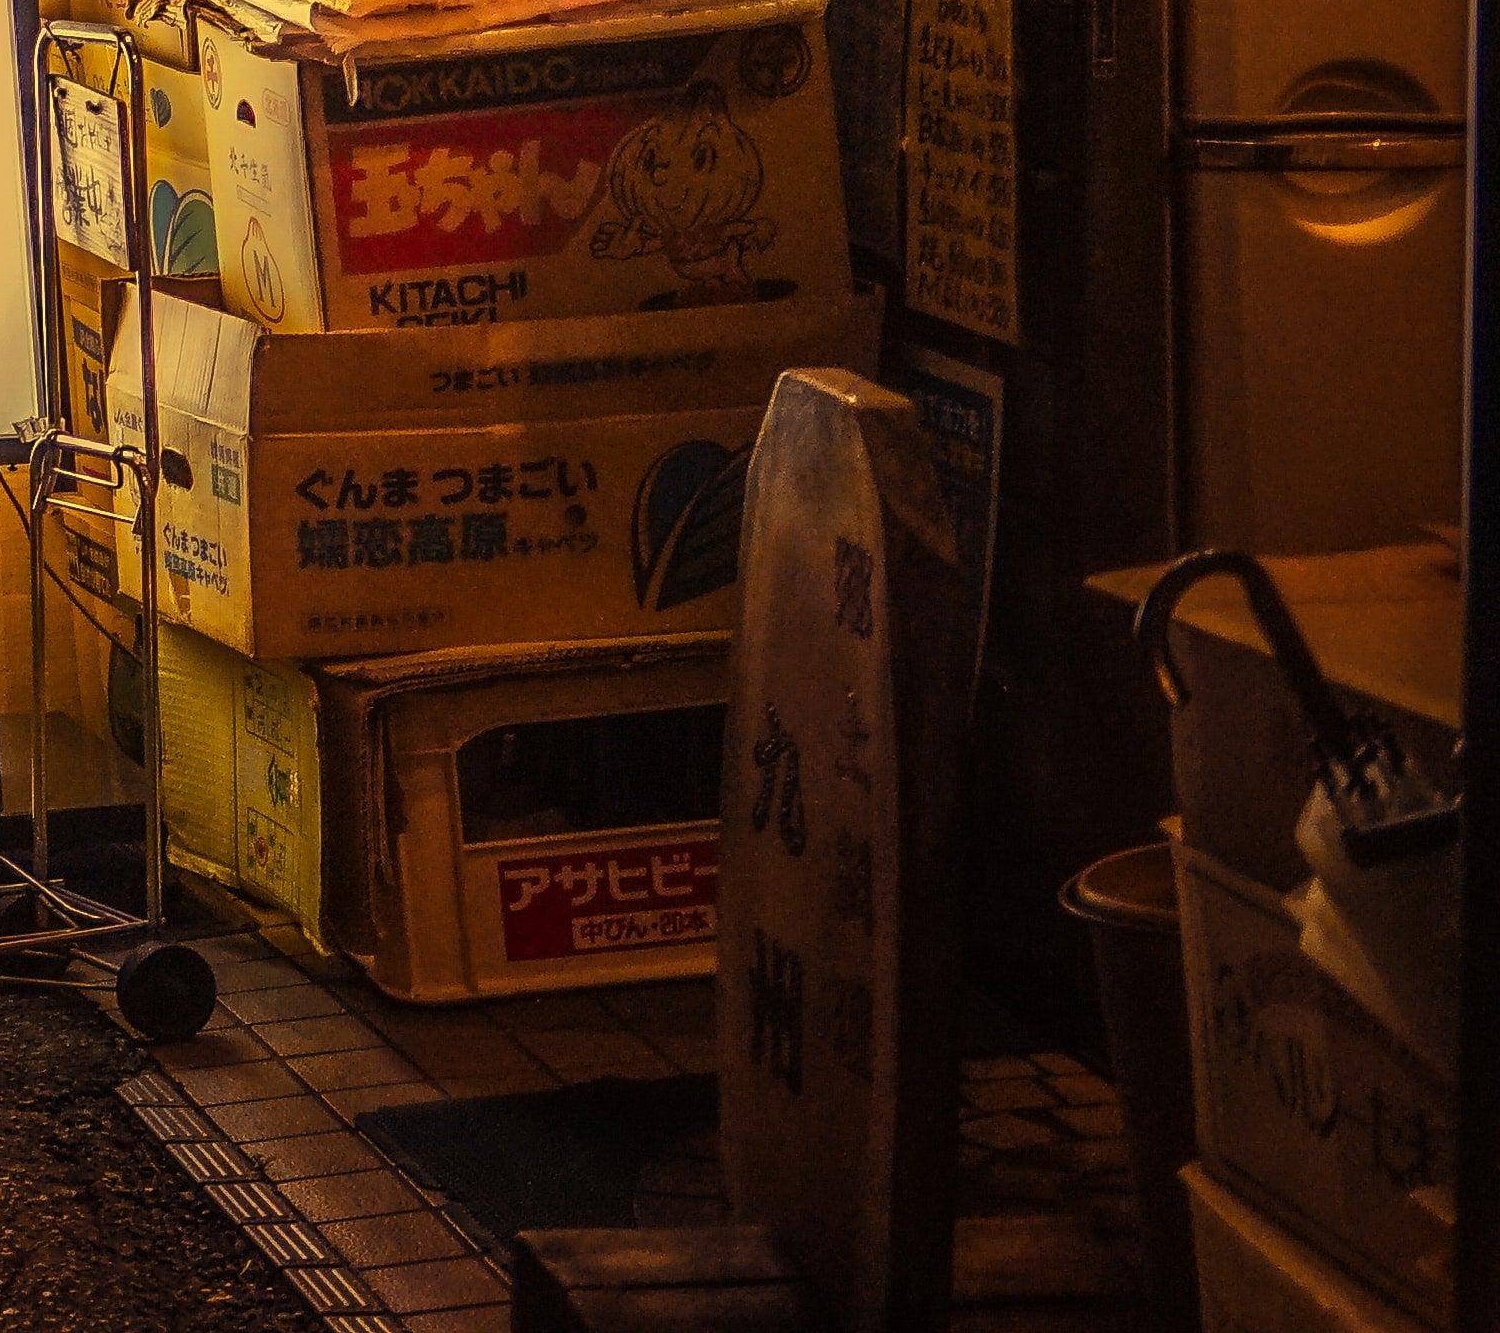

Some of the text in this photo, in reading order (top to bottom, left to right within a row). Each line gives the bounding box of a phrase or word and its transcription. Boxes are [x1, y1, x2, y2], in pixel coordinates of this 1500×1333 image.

[368, 270, 527, 317] KITACHI
[295, 467, 420, 511] ぐんま
[430, 456, 598, 506] つまごい
